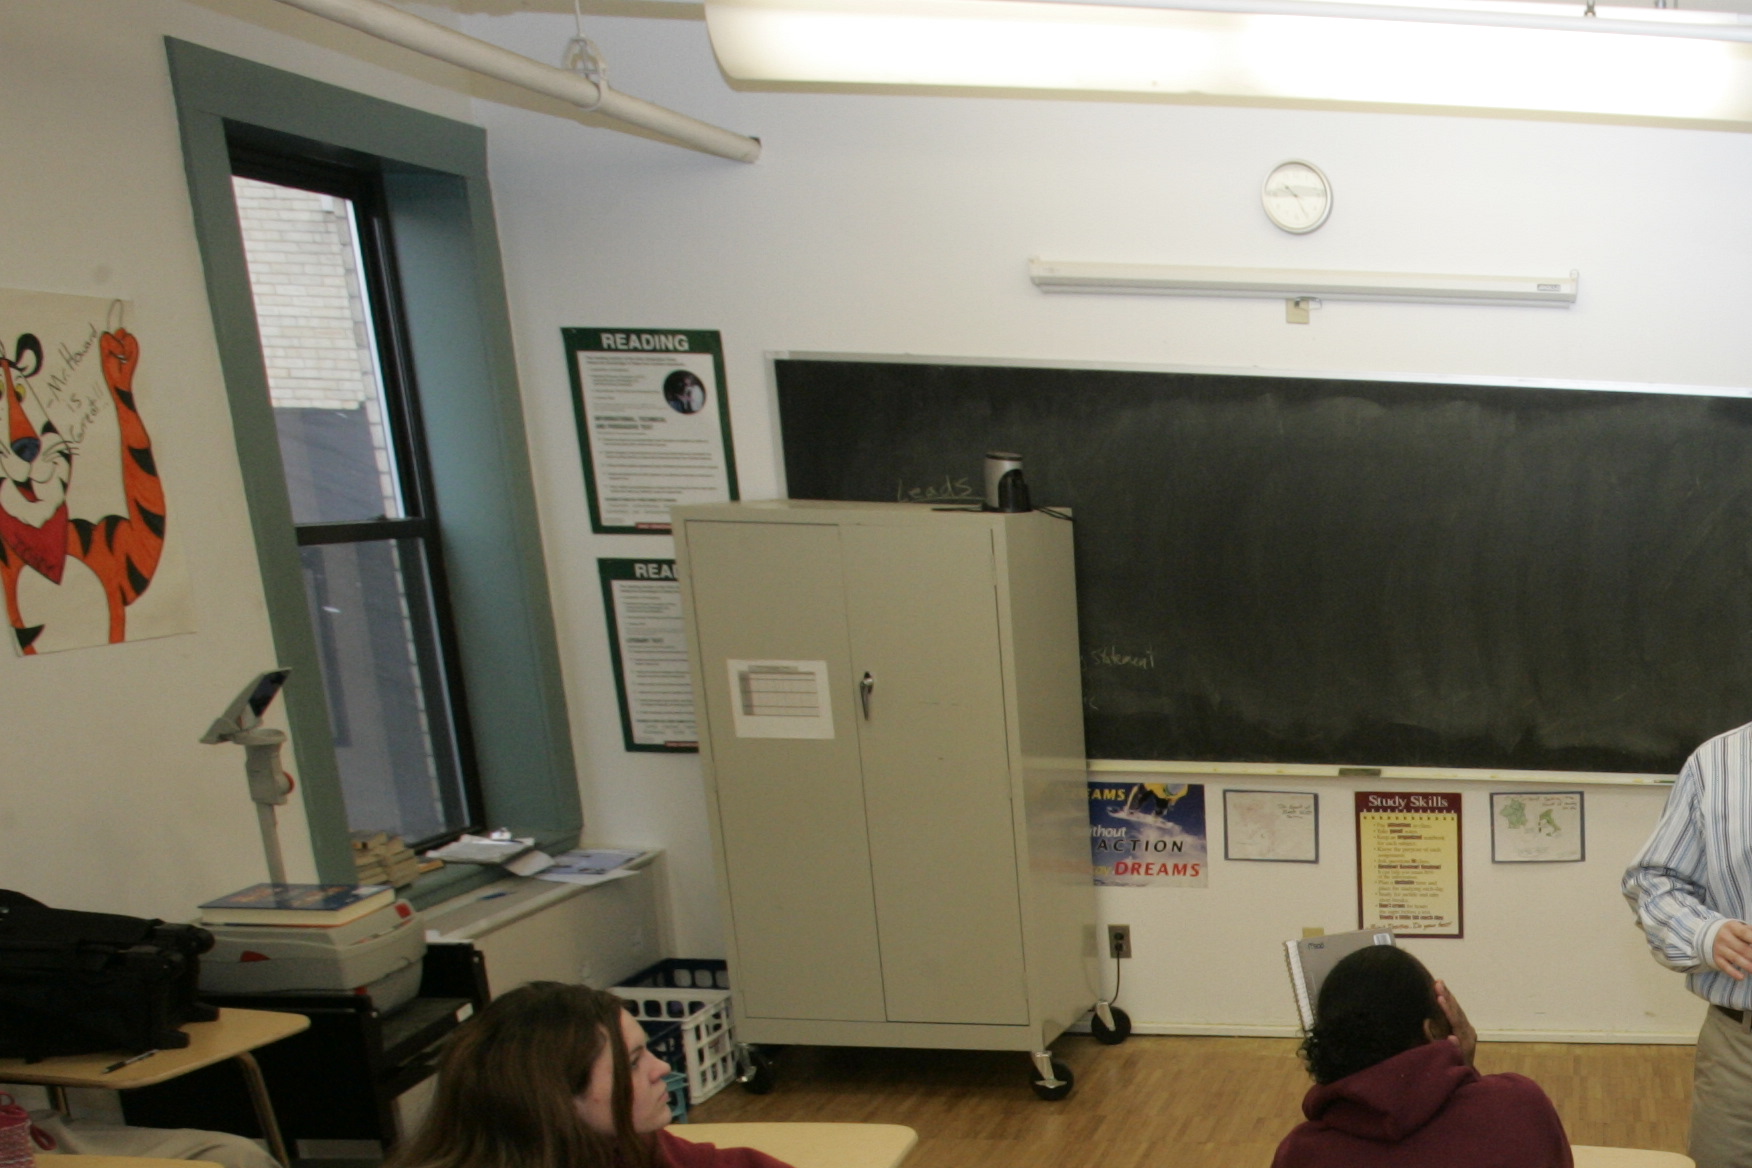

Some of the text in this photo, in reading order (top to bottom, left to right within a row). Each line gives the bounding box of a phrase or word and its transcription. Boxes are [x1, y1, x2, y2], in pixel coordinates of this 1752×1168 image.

[601, 332, 689, 350] READING
[1368, 795, 1448, 809] Study Skills
[1091, 824, 1127, 838] thout
[1097, 839, 1184, 852] ACTION
[1114, 861, 1201, 877] DREAMS
